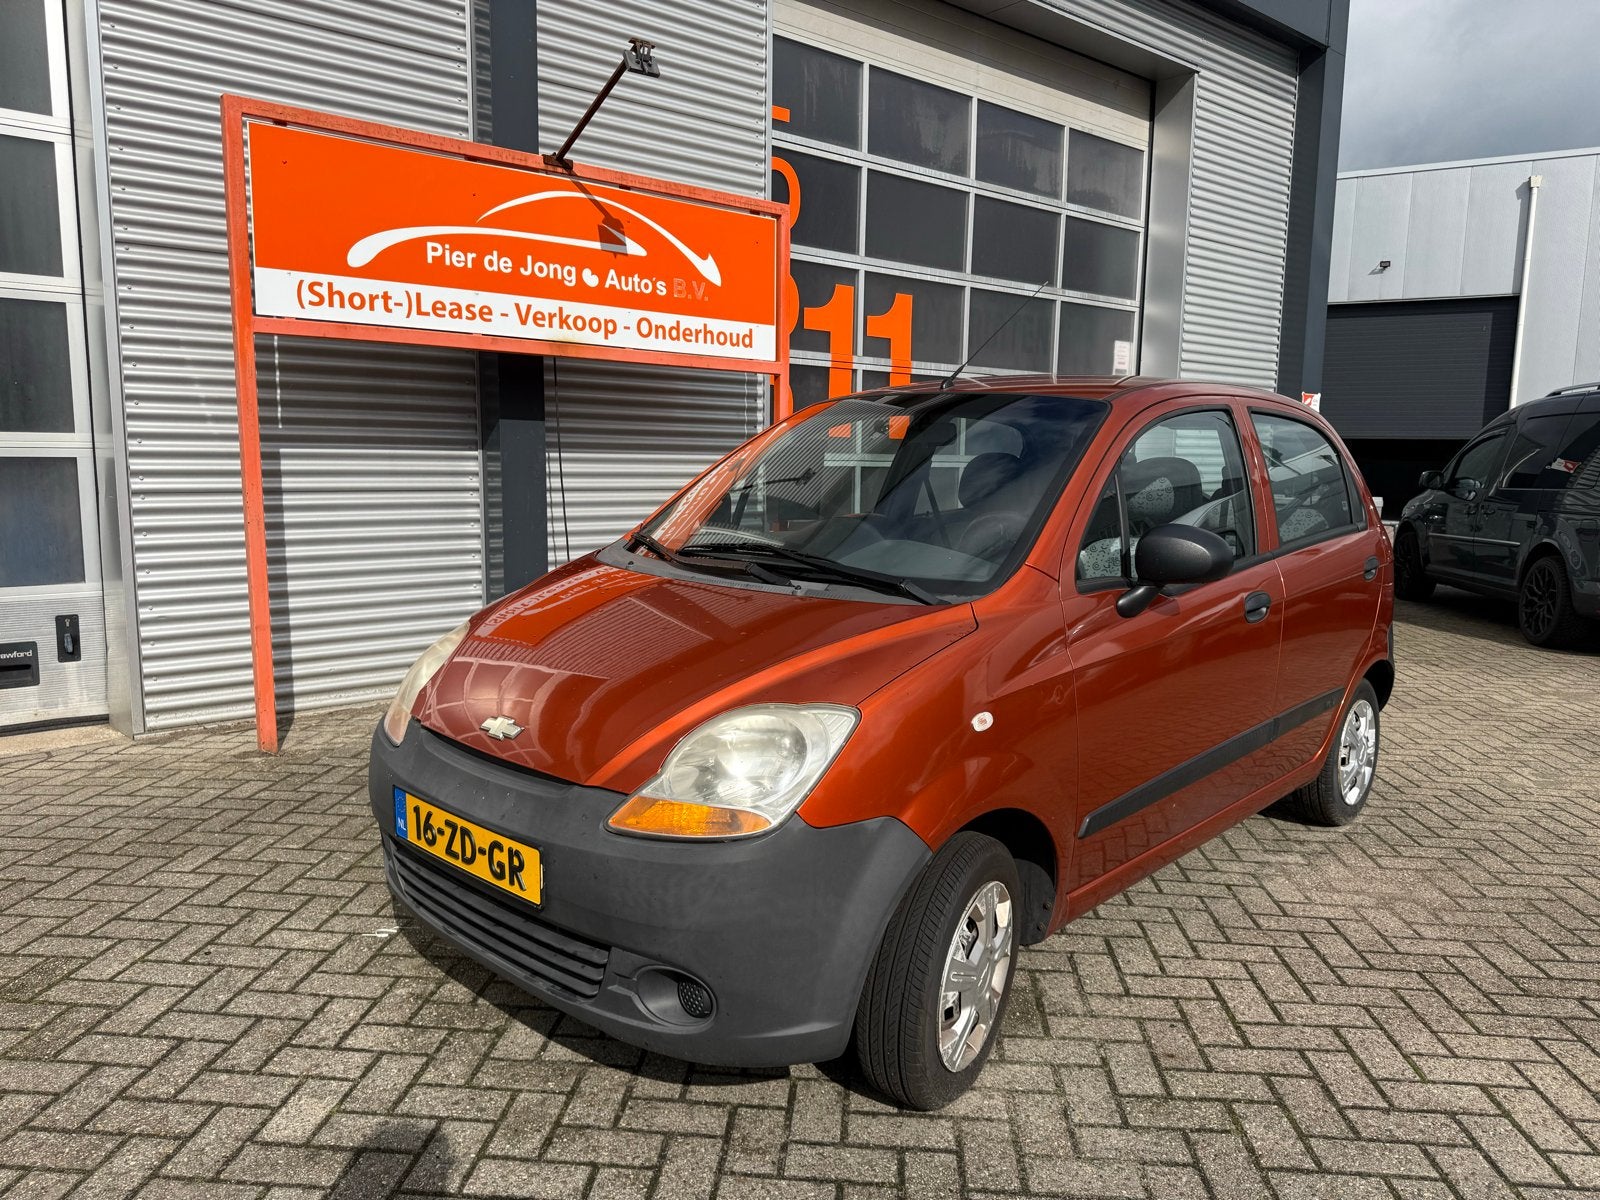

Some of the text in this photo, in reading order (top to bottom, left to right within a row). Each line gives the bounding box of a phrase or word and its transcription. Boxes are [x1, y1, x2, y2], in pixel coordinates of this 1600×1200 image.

[426, 241, 709, 301] Pier de Jong Auto's B.V.
[296, 279, 494, 323] (Short-)Lease
[514, 302, 618, 341] Verkoop
[636, 316, 753, 349] Onderhoud
[412, 804, 527, 892] 16-ZD-GR
